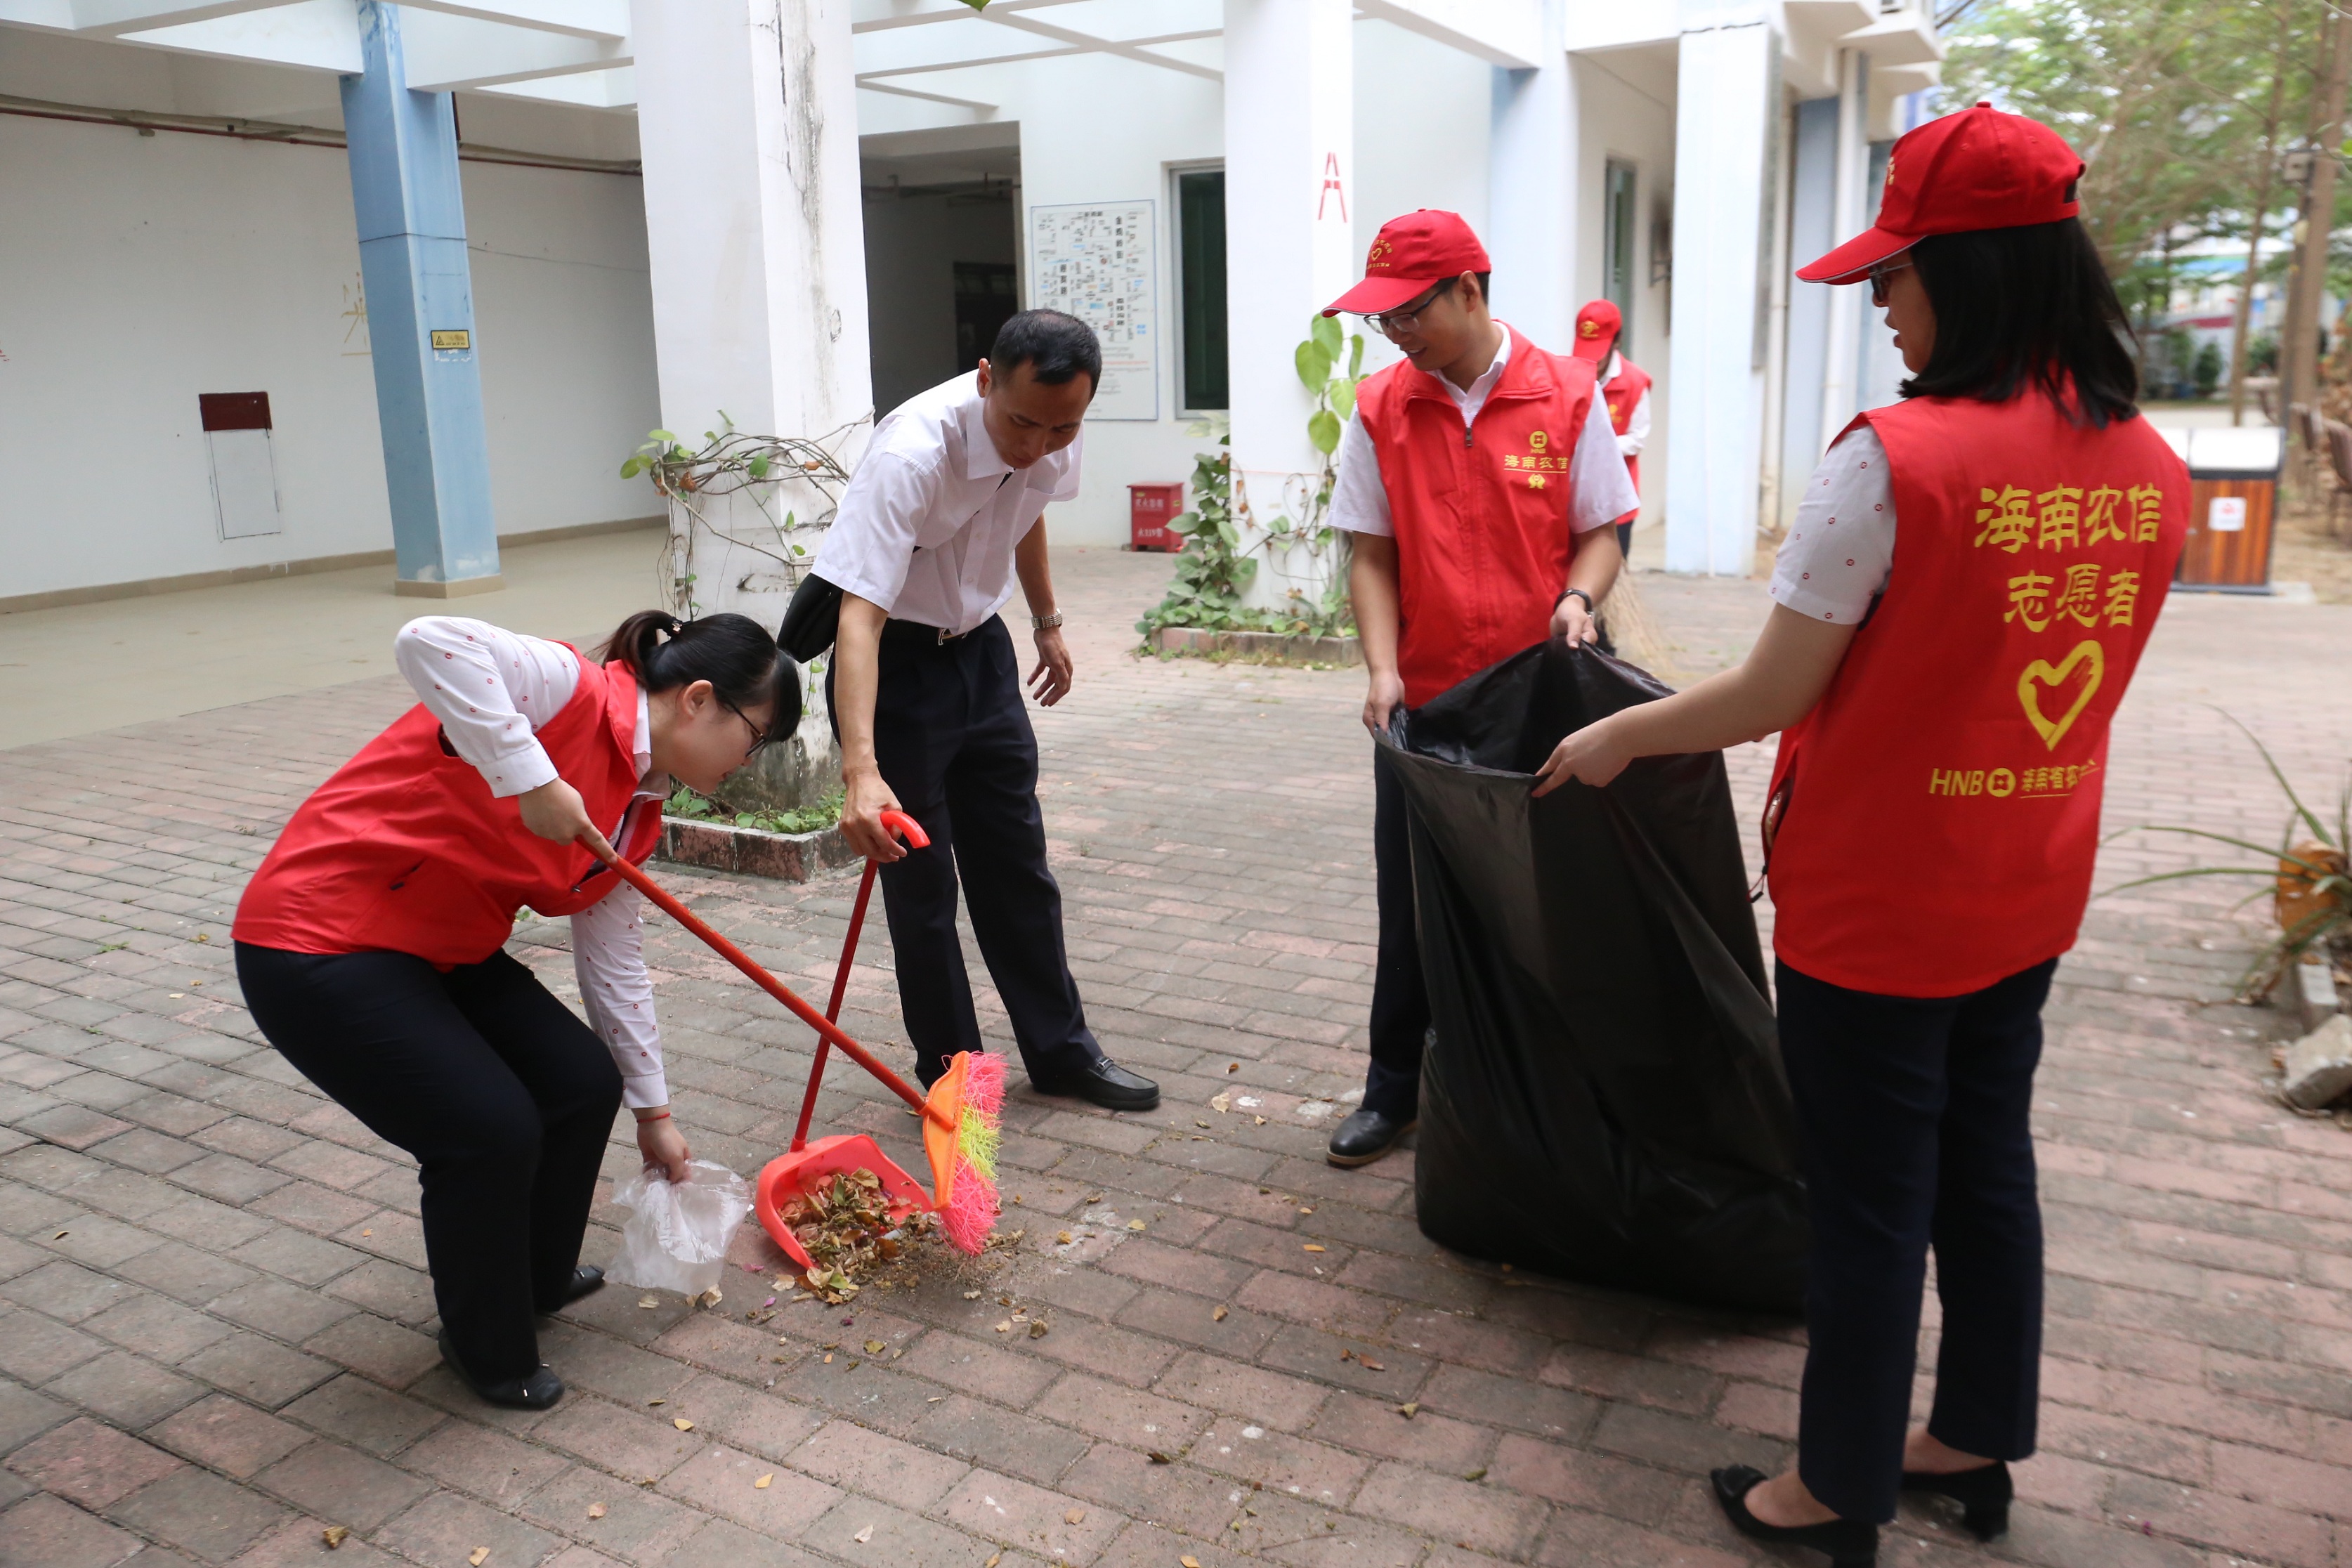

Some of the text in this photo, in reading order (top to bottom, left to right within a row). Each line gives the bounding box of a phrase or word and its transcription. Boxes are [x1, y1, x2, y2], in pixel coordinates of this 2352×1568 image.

[1319, 152, 1347, 223] A
[1505, 455, 1568, 469] 海南农信
[1975, 483, 2162, 553] 海南农信
[2004, 563, 2140, 632] 志愿者
[1929, 768, 1985, 796] HNB
